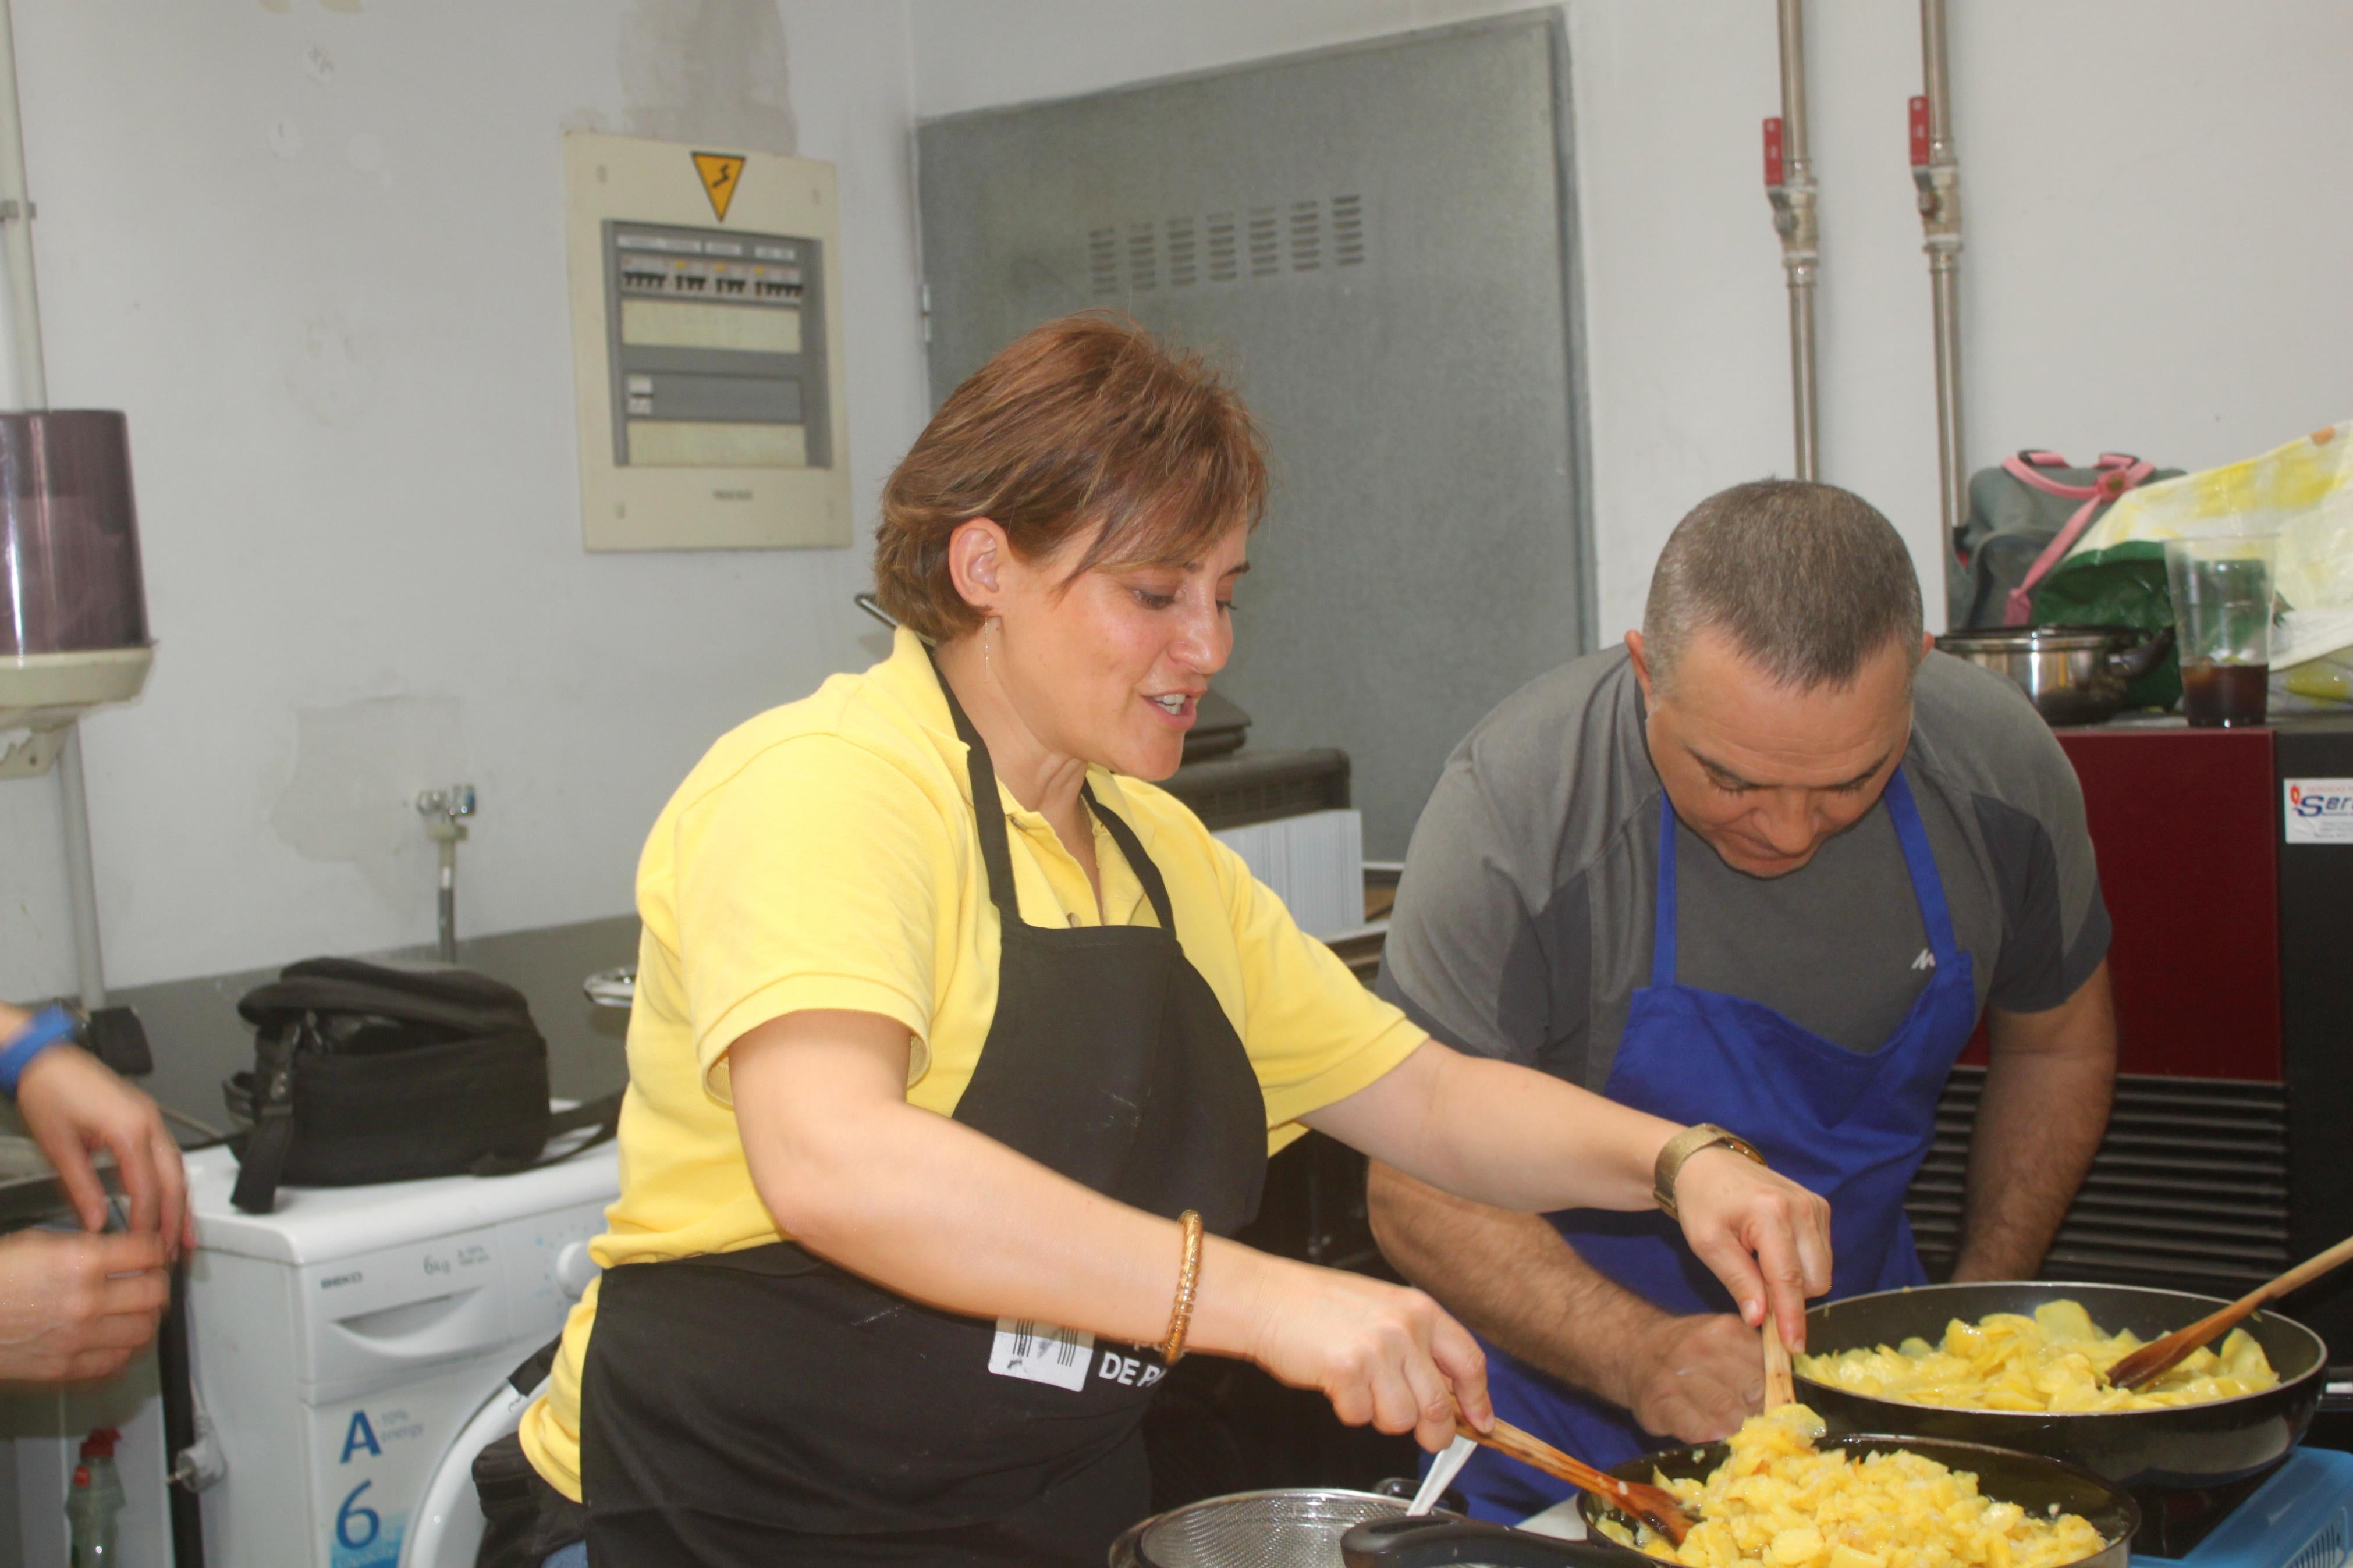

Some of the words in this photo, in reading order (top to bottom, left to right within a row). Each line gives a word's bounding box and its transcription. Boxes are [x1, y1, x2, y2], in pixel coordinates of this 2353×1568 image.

[2292, 794, 2353, 817] Ser
[1098, 1350, 1141, 1385] DE
[1137, 1363, 1168, 1387] P
[339, 1409, 382, 1465] A
[336, 1478, 380, 1550] 6
